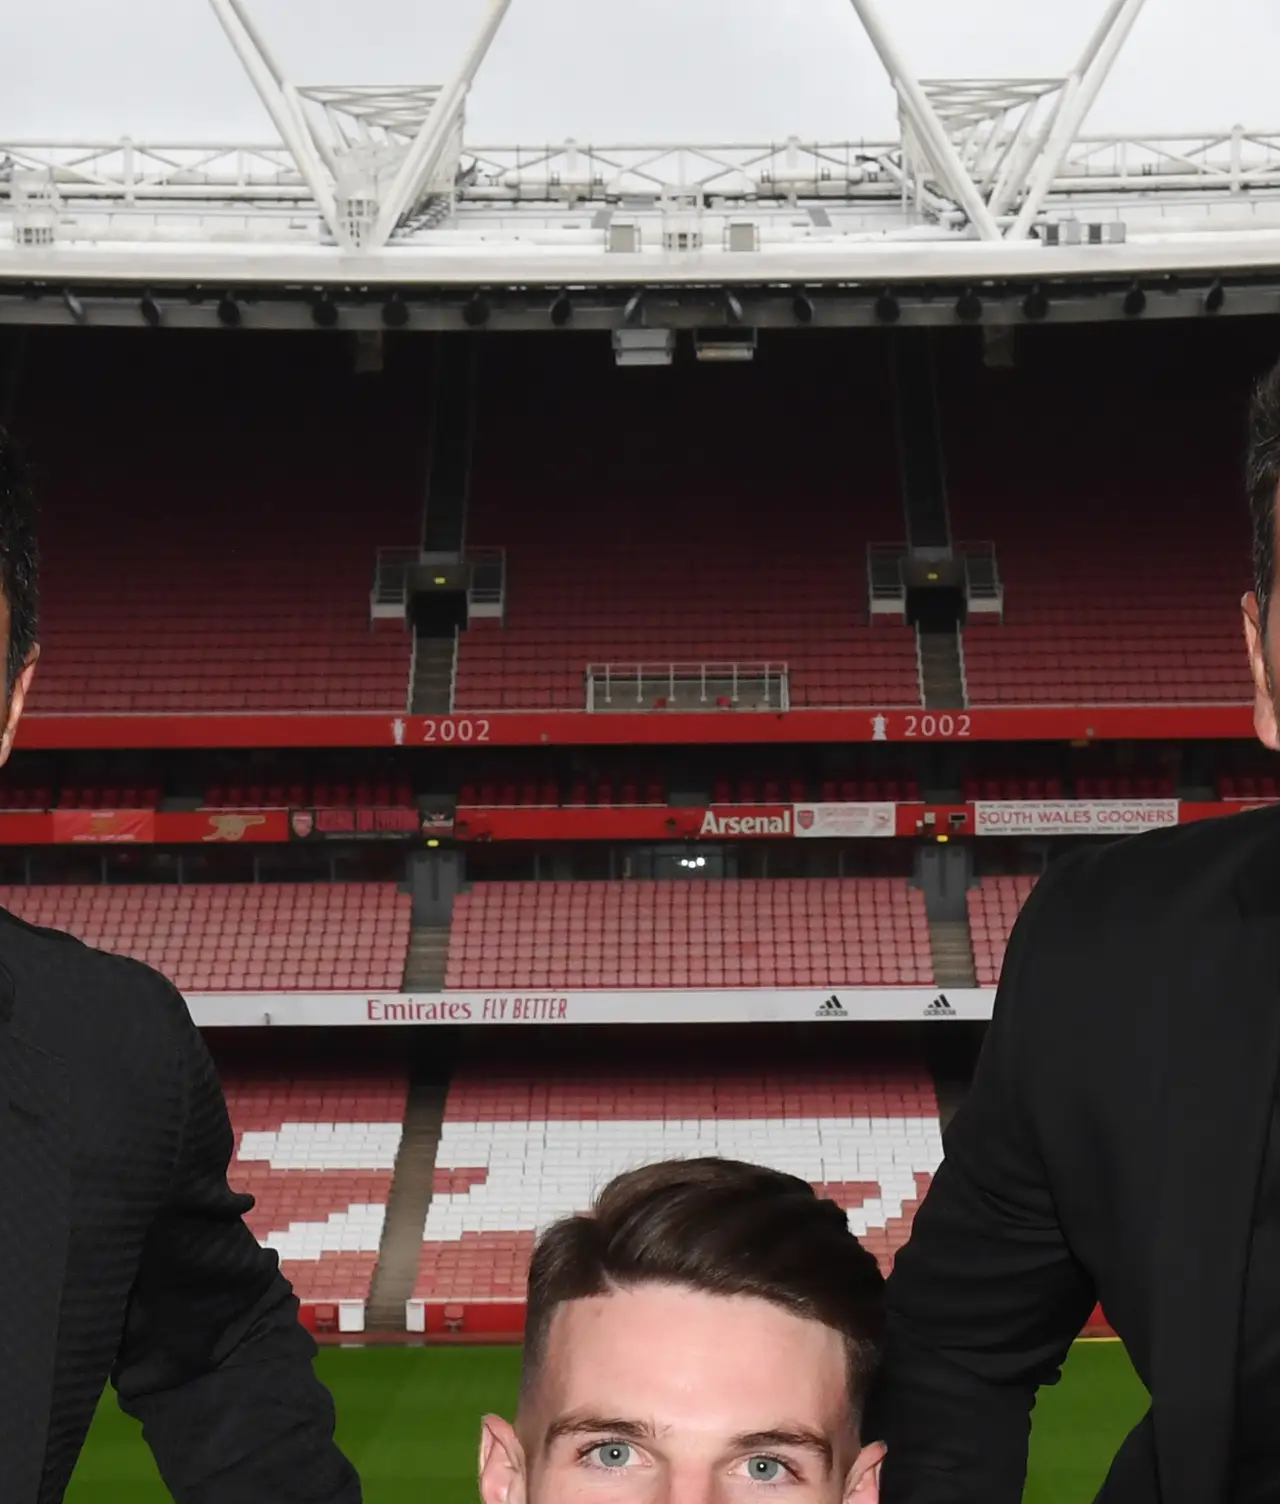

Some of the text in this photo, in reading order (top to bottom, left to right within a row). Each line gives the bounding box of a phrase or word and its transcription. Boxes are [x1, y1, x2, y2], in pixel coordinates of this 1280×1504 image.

[422, 719, 490, 742] 2002
[903, 714, 971, 737] 2002
[699, 809, 791, 835] Arsenal
[978, 809, 1176, 825] SOUTH WALES GOONERS
[367, 997, 568, 1022] Emirates FLY BETTER
